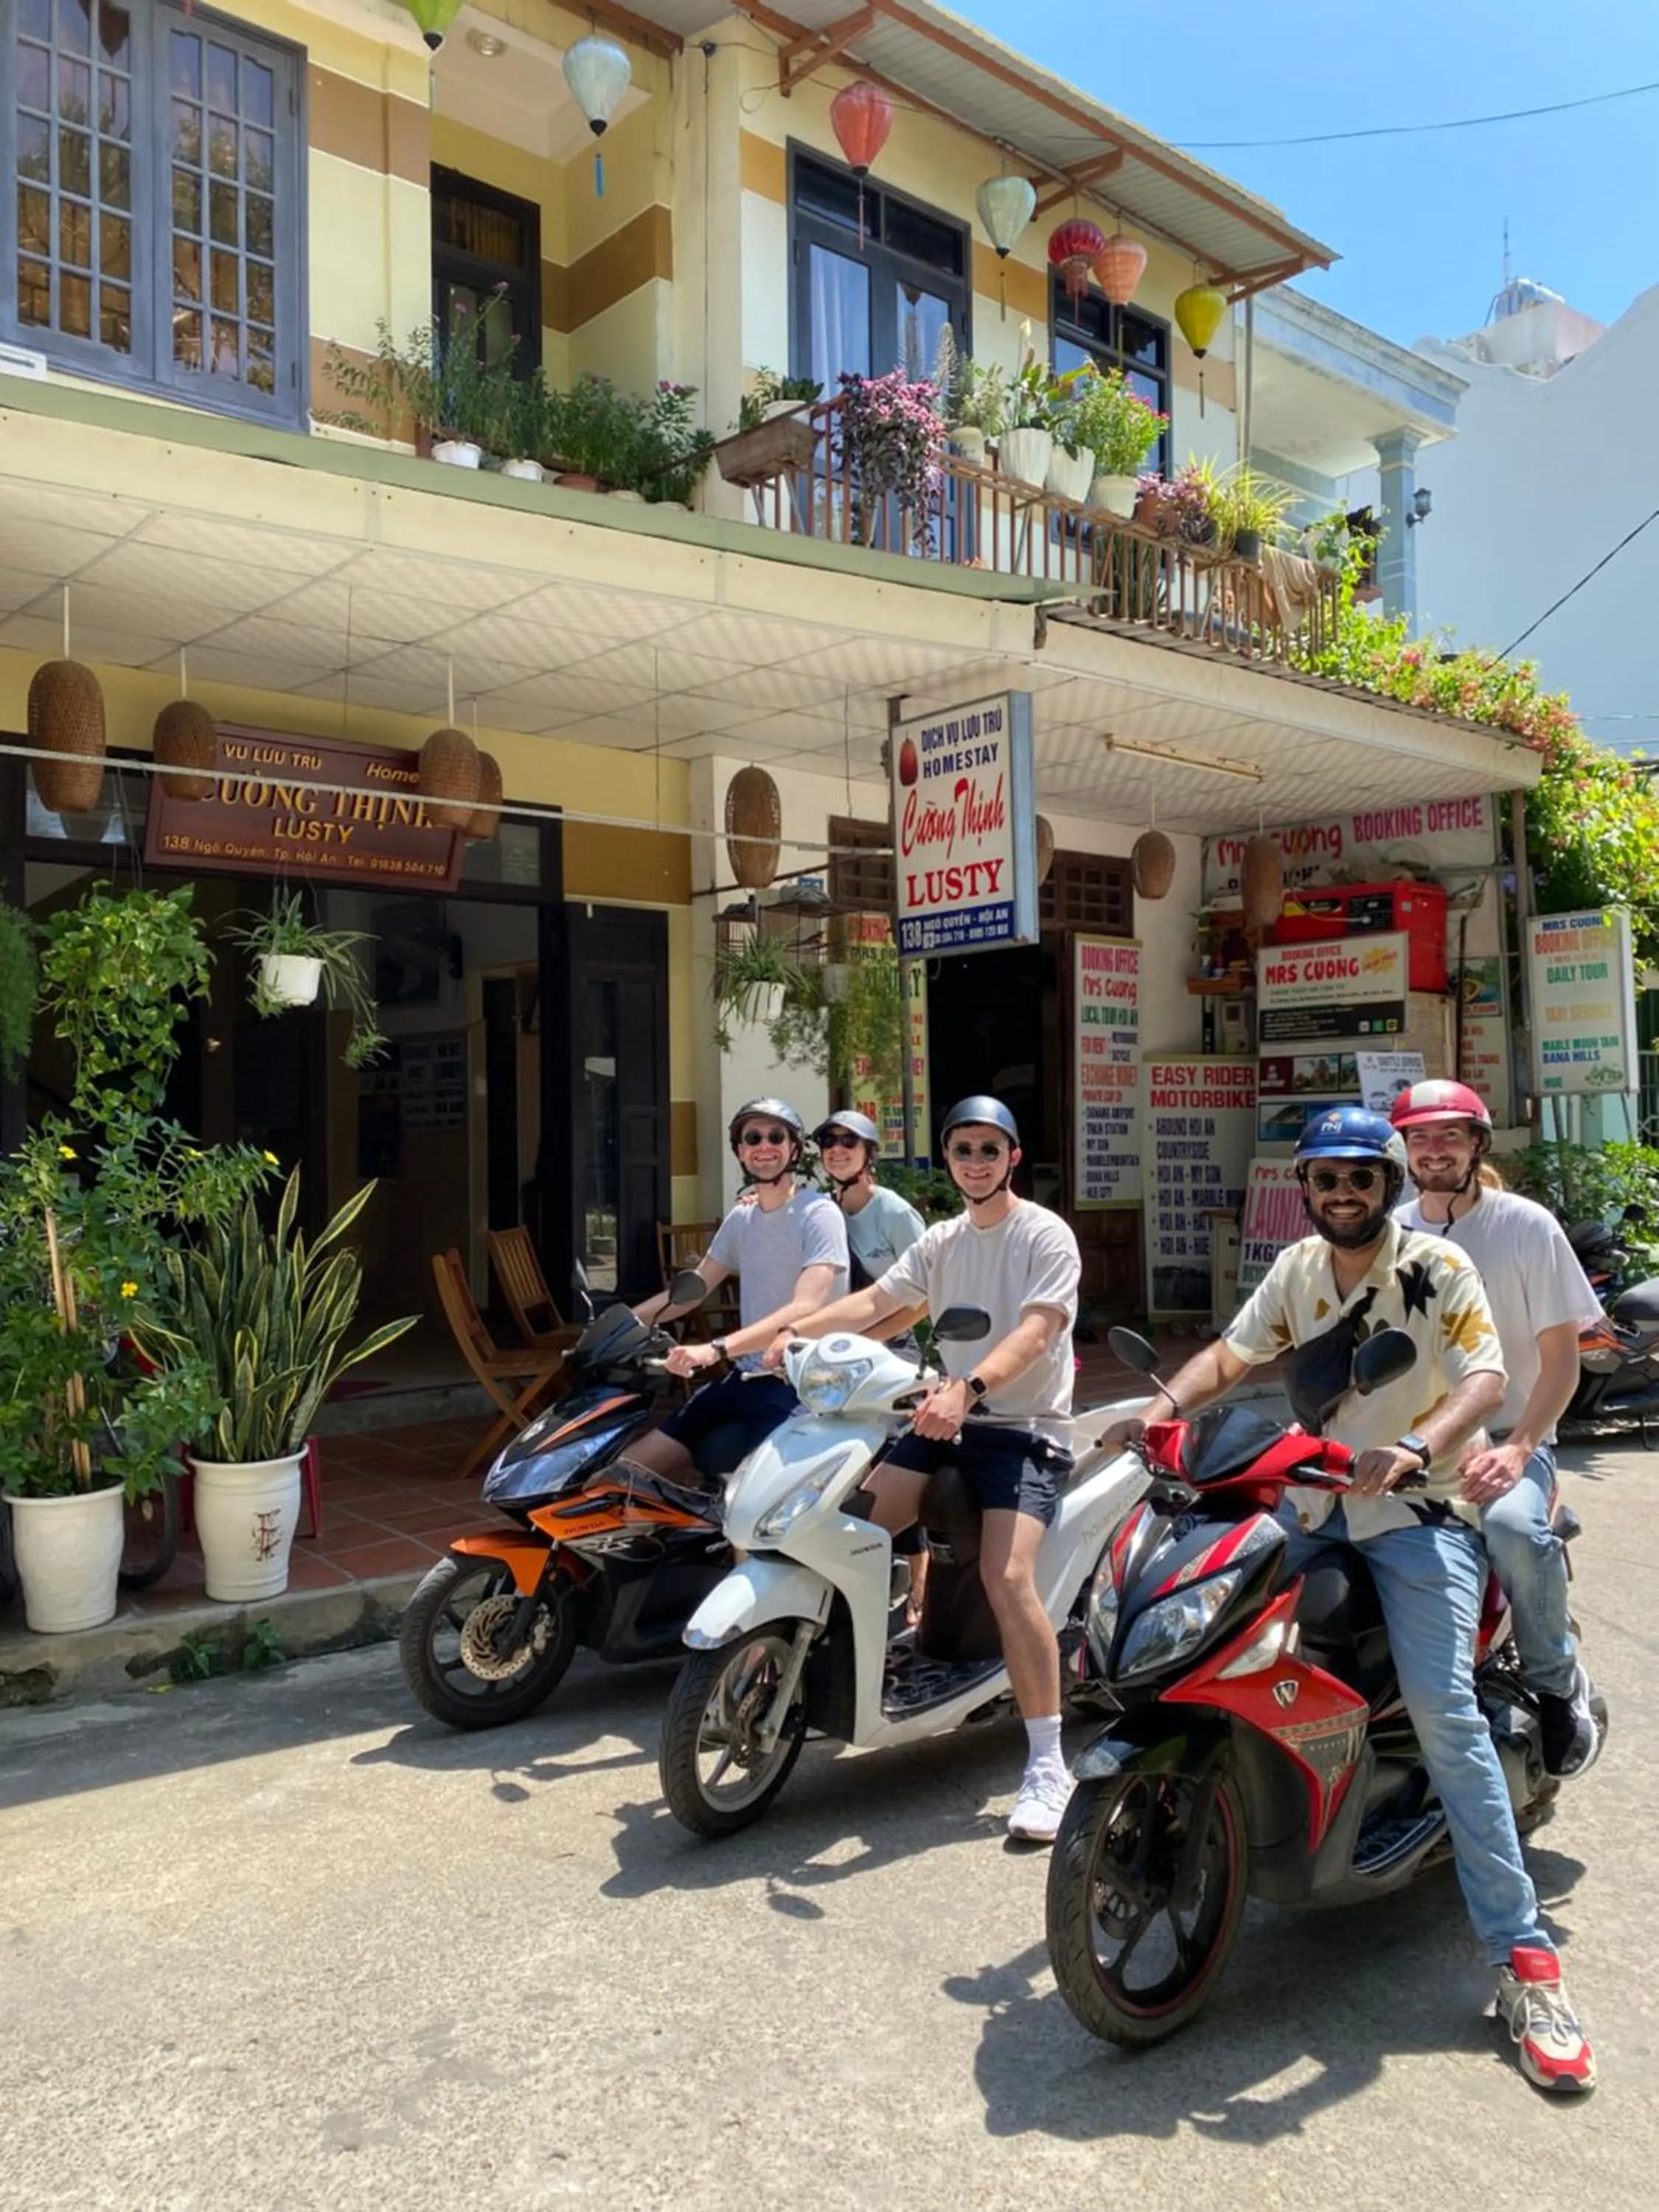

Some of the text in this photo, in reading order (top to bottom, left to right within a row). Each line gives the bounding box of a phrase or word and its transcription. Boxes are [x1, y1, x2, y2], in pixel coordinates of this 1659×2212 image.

[923, 742, 998, 779] HOMESTAY
[366, 762, 420, 784] Home
[274, 817, 354, 844] LUSTY
[1352, 808, 1422, 844] BOOKING
[1427, 796, 1484, 834] OFFICE
[164, 835, 189, 849] 138
[906, 858, 1004, 907] LUSTY
[1569, 915, 1604, 928] CUON
[901, 919, 922, 950] 138
[1265, 964, 1298, 986] MRS
[1303, 958, 1360, 981] CUONG
[1546, 962, 1609, 984] DAILY TOUR
[1572, 1050, 1600, 1062] HILLS
[1151, 1066, 1197, 1085] EASY
[1203, 1066, 1254, 1085] RIDER
[1150, 1090, 1256, 1108] MOTORBIKE
[1245, 1186, 1315, 1240] LAUND
